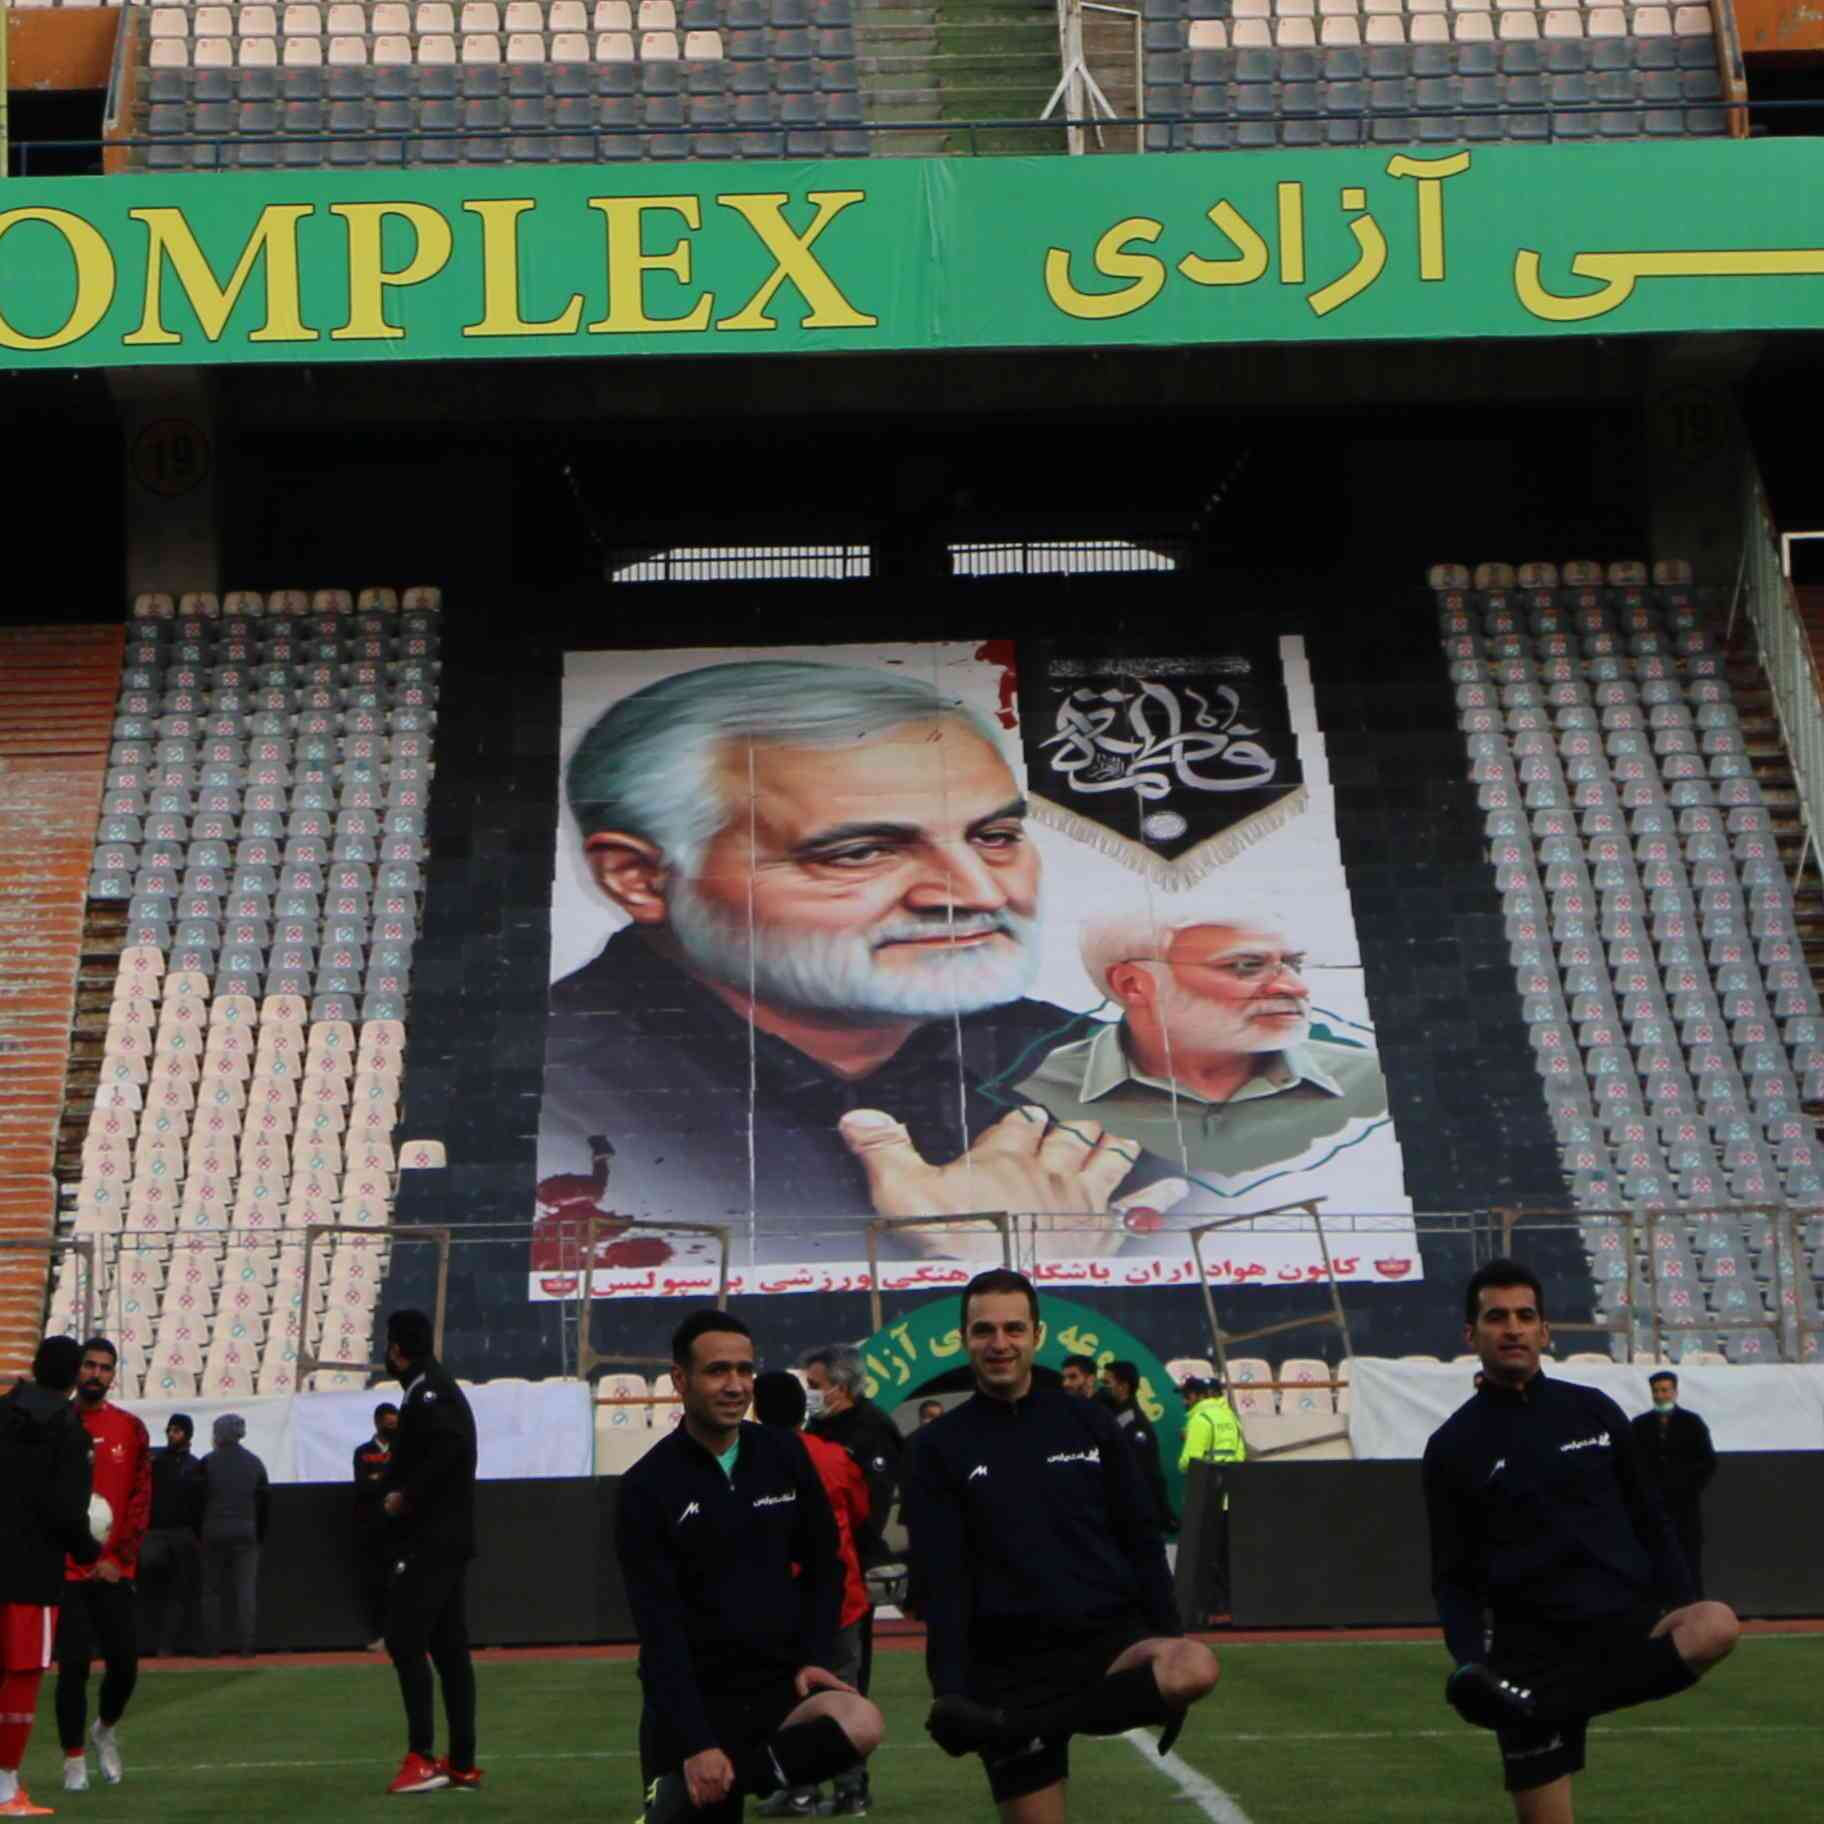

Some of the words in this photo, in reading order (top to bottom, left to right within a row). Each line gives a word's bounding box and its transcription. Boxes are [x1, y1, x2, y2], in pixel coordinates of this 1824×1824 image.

[1043, 150, 1471, 319] آزادی
[143, 432, 196, 479] 19
[881, 1263, 970, 1289] هنگی
